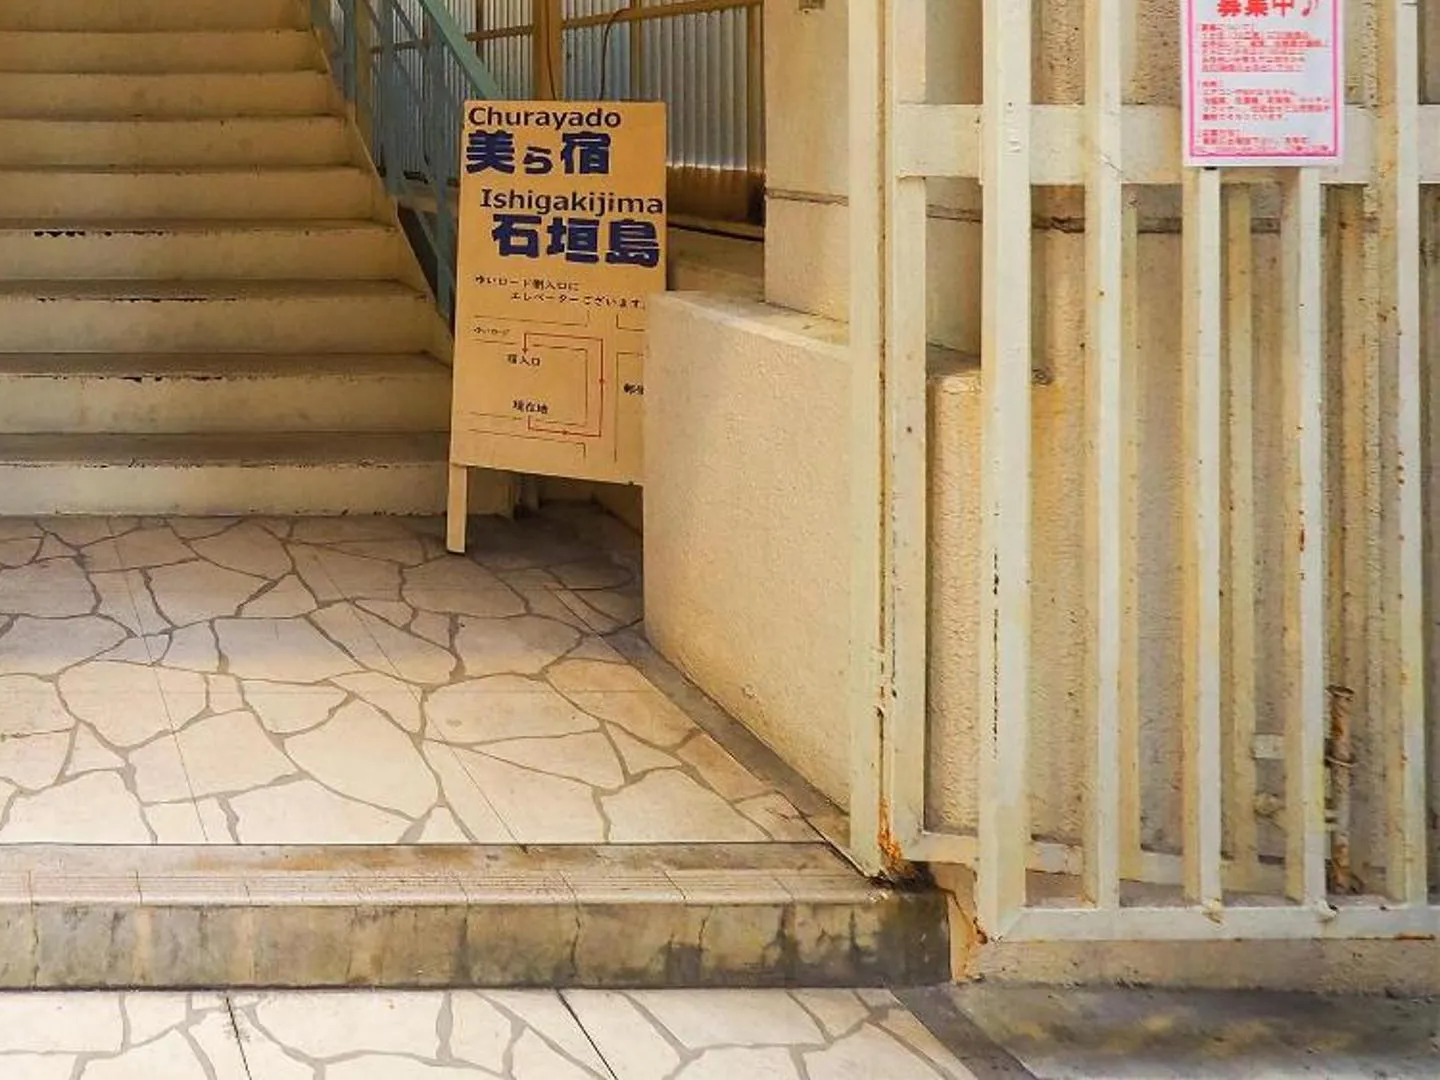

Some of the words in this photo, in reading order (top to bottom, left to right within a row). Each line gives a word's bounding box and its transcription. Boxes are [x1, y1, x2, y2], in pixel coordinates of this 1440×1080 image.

[468, 107, 622, 131] Churayado
[466, 129, 611, 175] 美ら宿
[480, 188, 664, 217] Ishigakijima
[491, 213, 660, 269] 石垣島
